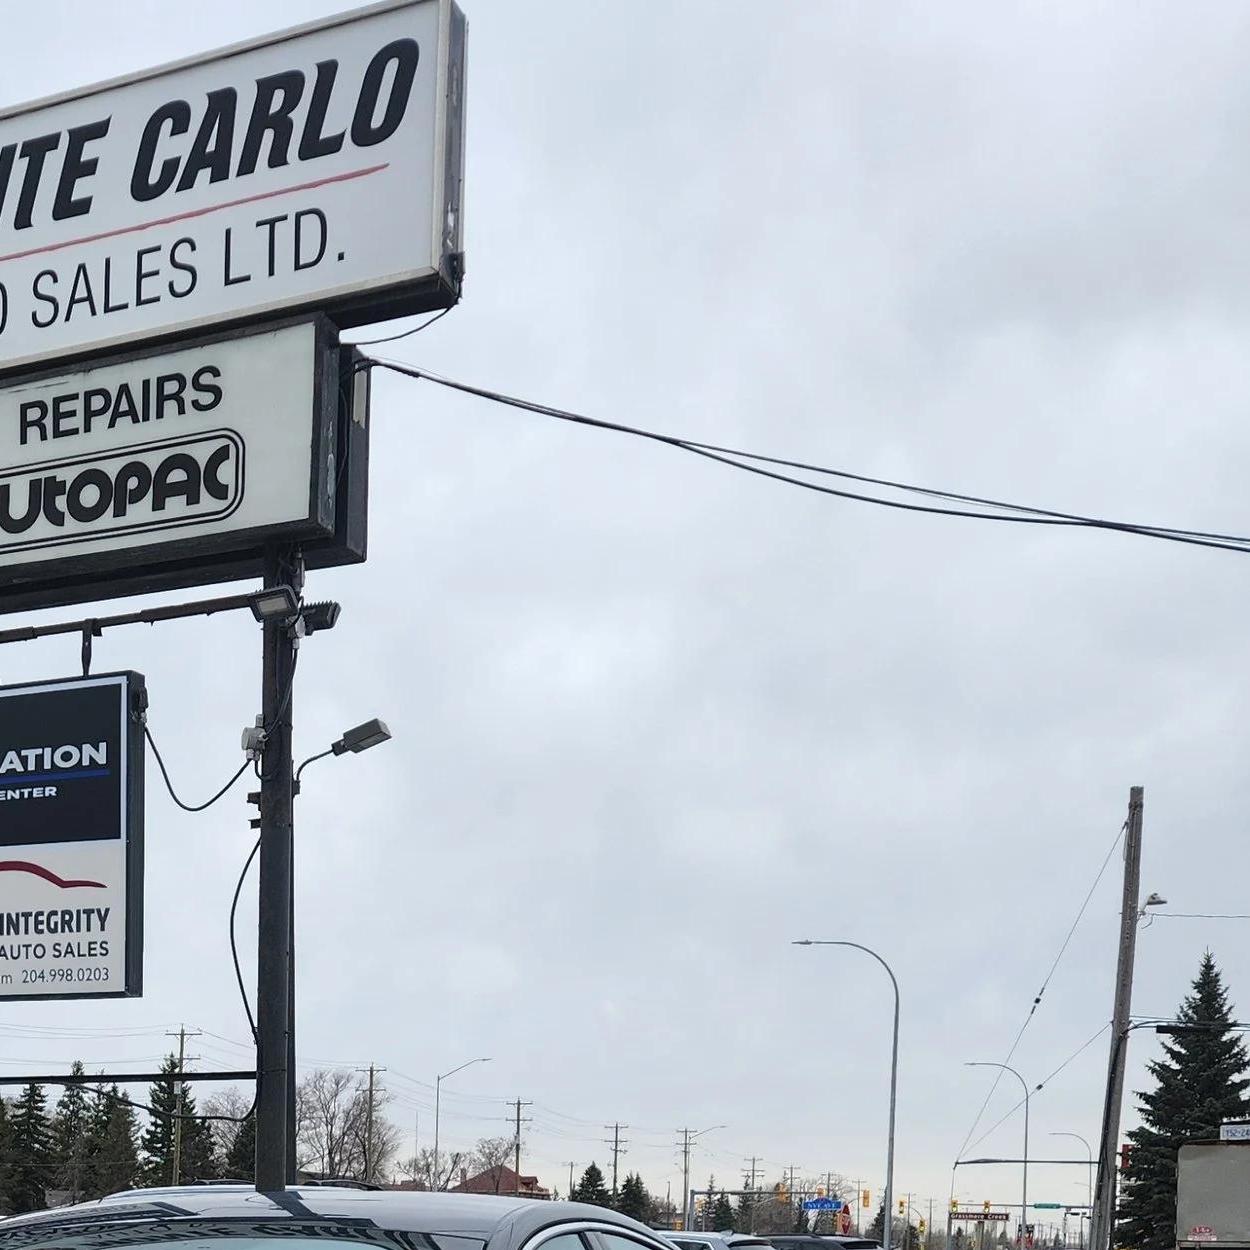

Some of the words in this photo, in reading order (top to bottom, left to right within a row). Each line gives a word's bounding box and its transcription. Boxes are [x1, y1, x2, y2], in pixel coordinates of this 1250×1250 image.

[130, 38, 419, 203] CARLO
[31, 238, 197, 329] SALES
[224, 208, 347, 287] LTD.
[19, 365, 224, 445] REPAIRS
[0, 907, 111, 937] INTEGRITY
[52, 940, 110, 959] SALES
[21, 967, 110, 985] 204.998.0203
[987, 1212, 1007, 1221] Creek
